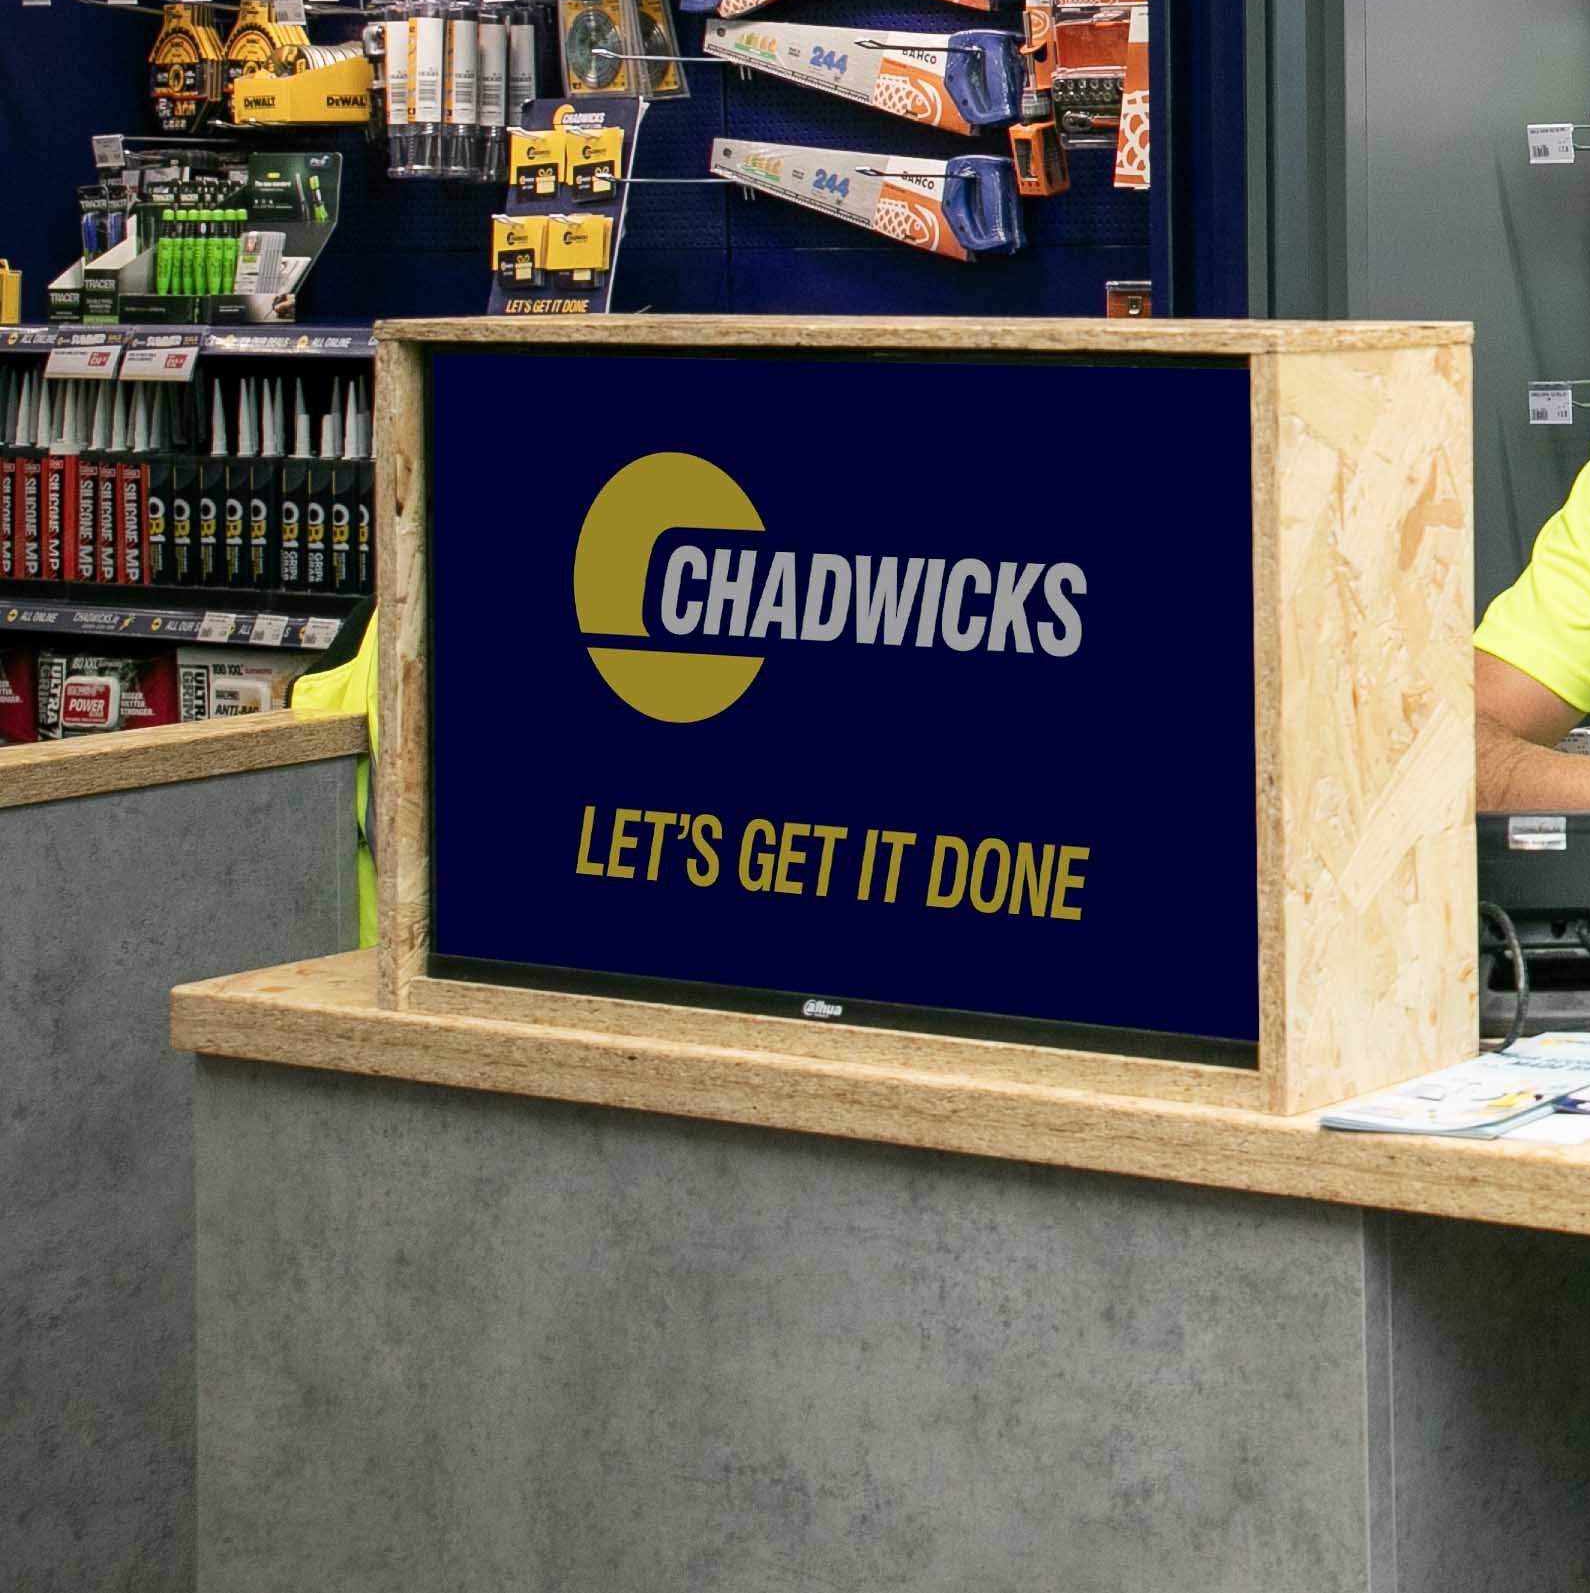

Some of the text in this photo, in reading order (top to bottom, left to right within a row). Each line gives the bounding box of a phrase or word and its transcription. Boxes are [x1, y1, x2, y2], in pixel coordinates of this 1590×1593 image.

[809, 46, 848, 75] 244
[813, 168, 850, 197] 244
[51, 293, 80, 303] TRACER
[84, 280, 115, 288] TRACER
[533, 300, 551, 313] GET
[552, 300, 562, 312] IT
[563, 300, 589, 312] DONE
[48, 473, 60, 571] SILICONE MP
[124, 483, 138, 582] SILICONE MP
[282, 501, 299, 547] OB1
[308, 503, 324, 549] OB1
[332, 504, 349, 550] OB1
[661, 545, 1088, 657] CHADWICKS
[69, 700, 104, 712] POWER
[575, 805, 1090, 921] LET'S GET IT DONE
